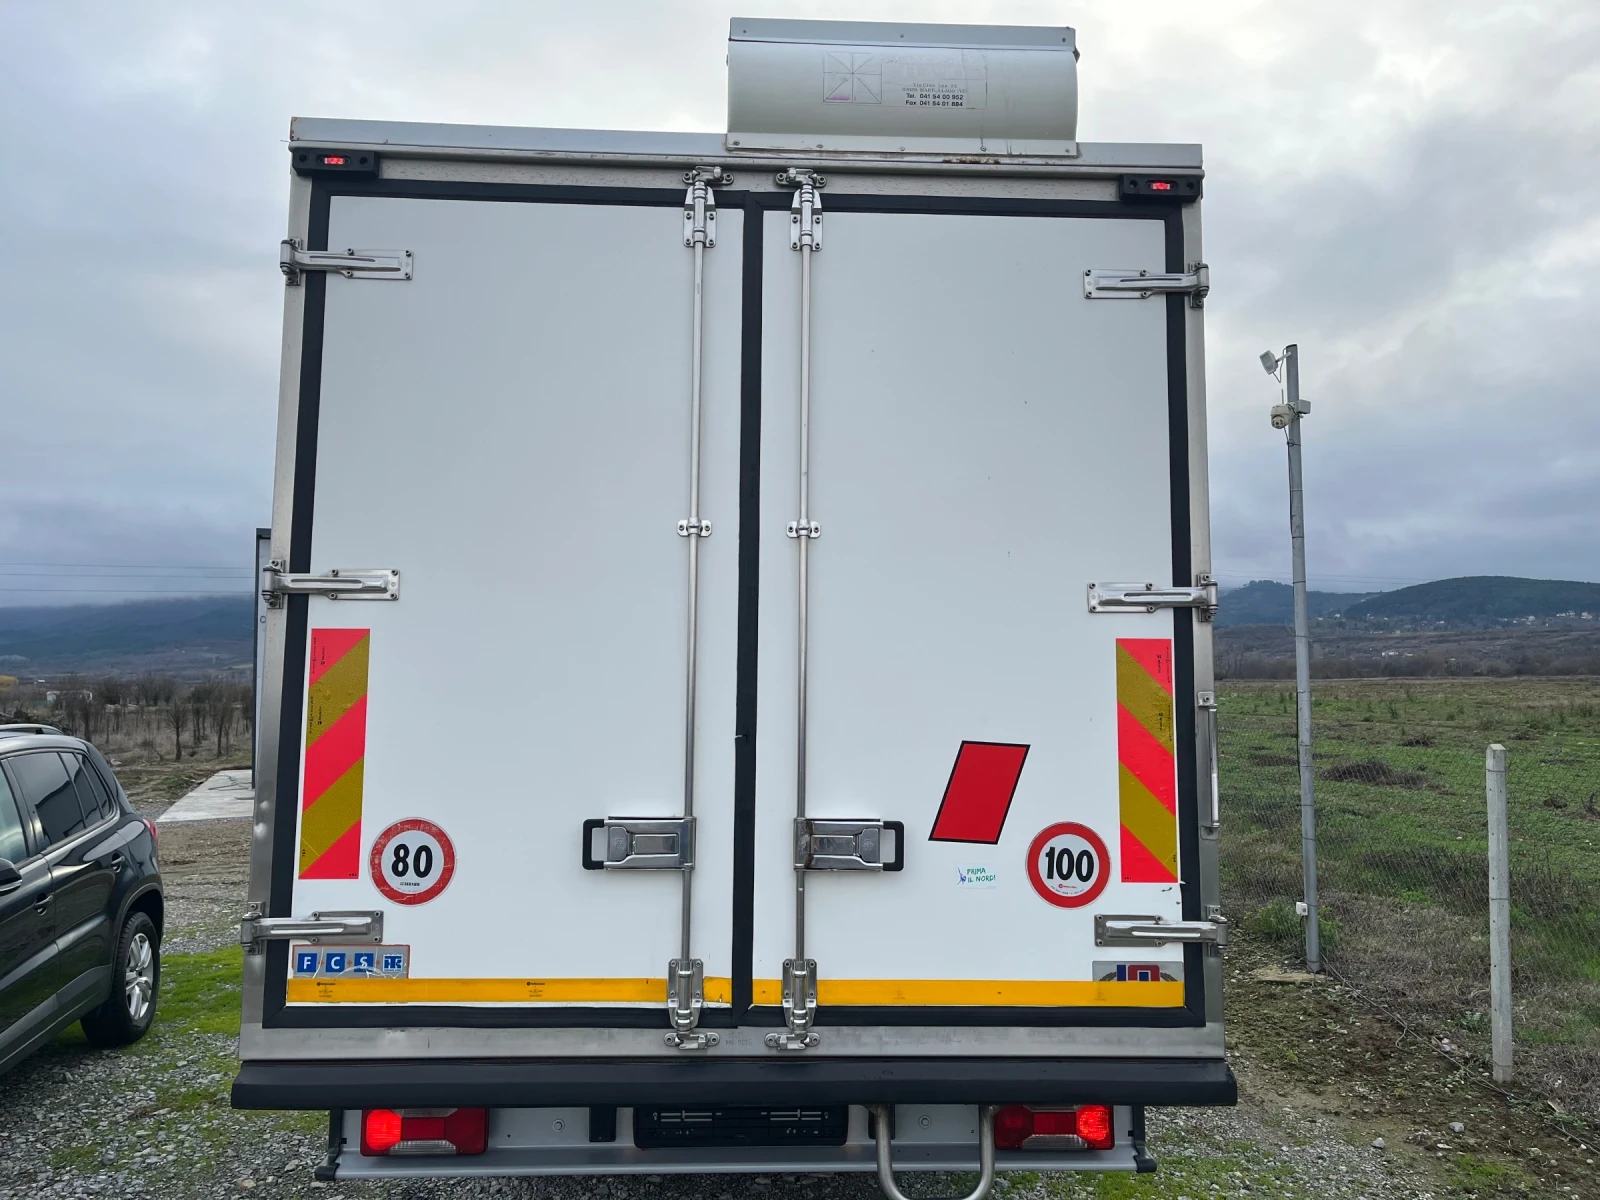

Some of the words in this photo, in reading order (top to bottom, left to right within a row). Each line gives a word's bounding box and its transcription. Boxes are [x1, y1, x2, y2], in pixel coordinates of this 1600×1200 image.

[391, 843, 433, 878] 80
[966, 867, 986, 875] PRIMA
[1045, 846, 1095, 883] 100
